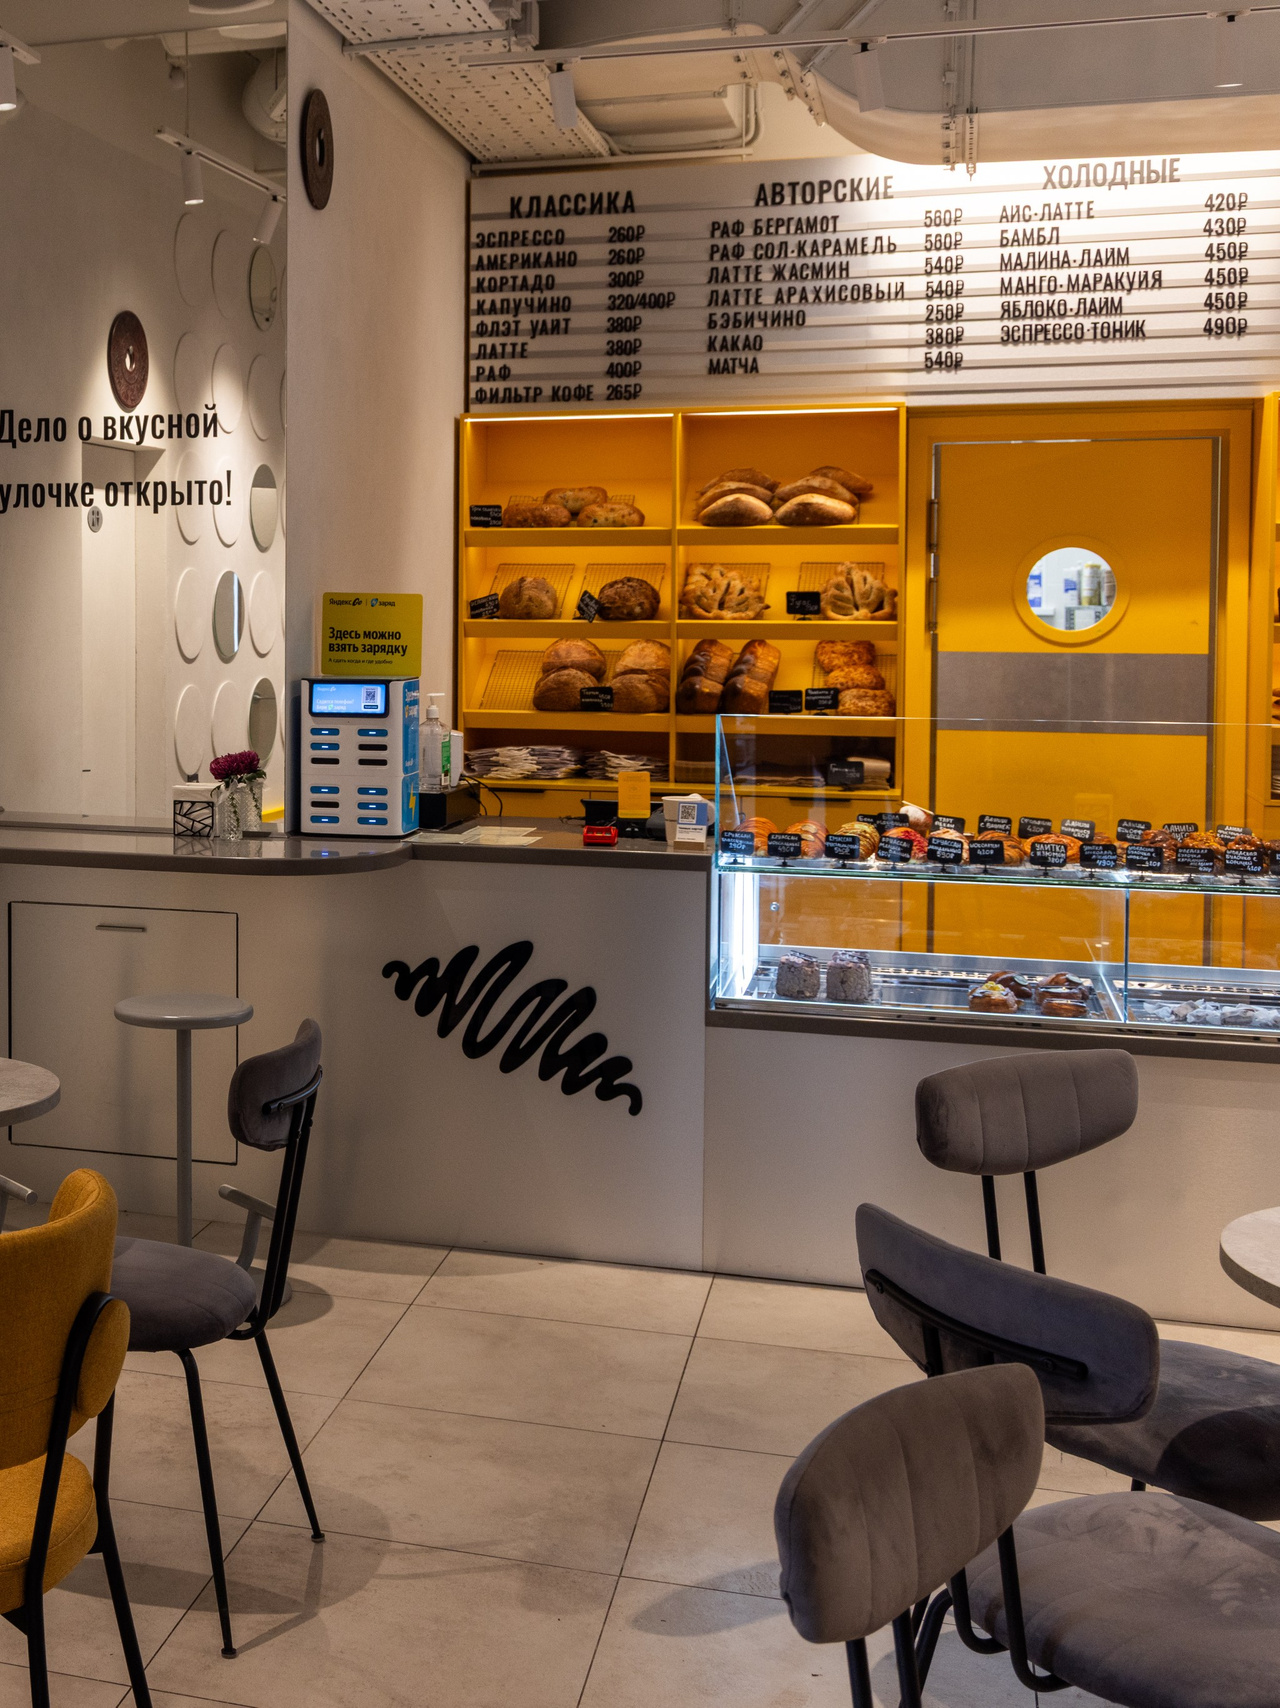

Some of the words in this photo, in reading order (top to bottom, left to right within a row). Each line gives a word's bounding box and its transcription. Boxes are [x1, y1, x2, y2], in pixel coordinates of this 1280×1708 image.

[1042, 158, 1181, 191] ХОЛОДНЫЕ
[754, 175, 895, 207] АВТОРСКИЕ
[509, 190, 636, 219] КЛАССИКА
[709, 219, 745, 238] РАФ
[753, 215, 840, 236] БЕРГАМОТ
[999, 226, 1060, 248] БАМБЛ
[475, 229, 565, 248] ЭСПРЕССО
[475, 250, 578, 271] АМЕРИКАНО
[709, 242, 745, 261] РАФ
[708, 265, 763, 284] ЛАТТЕ
[772, 260, 850, 281] ЖАСМИН
[475, 274, 556, 294] КОРТАДО
[708, 287, 763, 307] ЛАТТЕ
[774, 281, 906, 305] АРАХИСОВЫЙ
[475, 296, 571, 317] КАПУЧИНО
[475, 320, 521, 337] ФЛЭТ
[529, 318, 571, 339] УАЙТ
[708, 309, 806, 330] БЭБИЧИНО
[475, 342, 529, 360] ЛАТТЕ
[708, 334, 763, 353] КАКАО
[475, 364, 512, 382] РАФ
[708, 357, 760, 375] МАТЧА
[474, 386, 543, 404] ФИЛЬТР
[551, 384, 595, 402] КОФЕ
[77, 416, 92, 441] о
[103, 403, 218, 445] вкусной
[104, 469, 232, 514] открыто!
[329, 598, 352, 606] Яндекс
[328, 626, 361, 641] Здесь
[363, 630, 402, 641] можно
[328, 642, 359, 653] взять
[361, 643, 408, 657] зарядку
[1035, 843, 1066, 853] УЛИТКА
